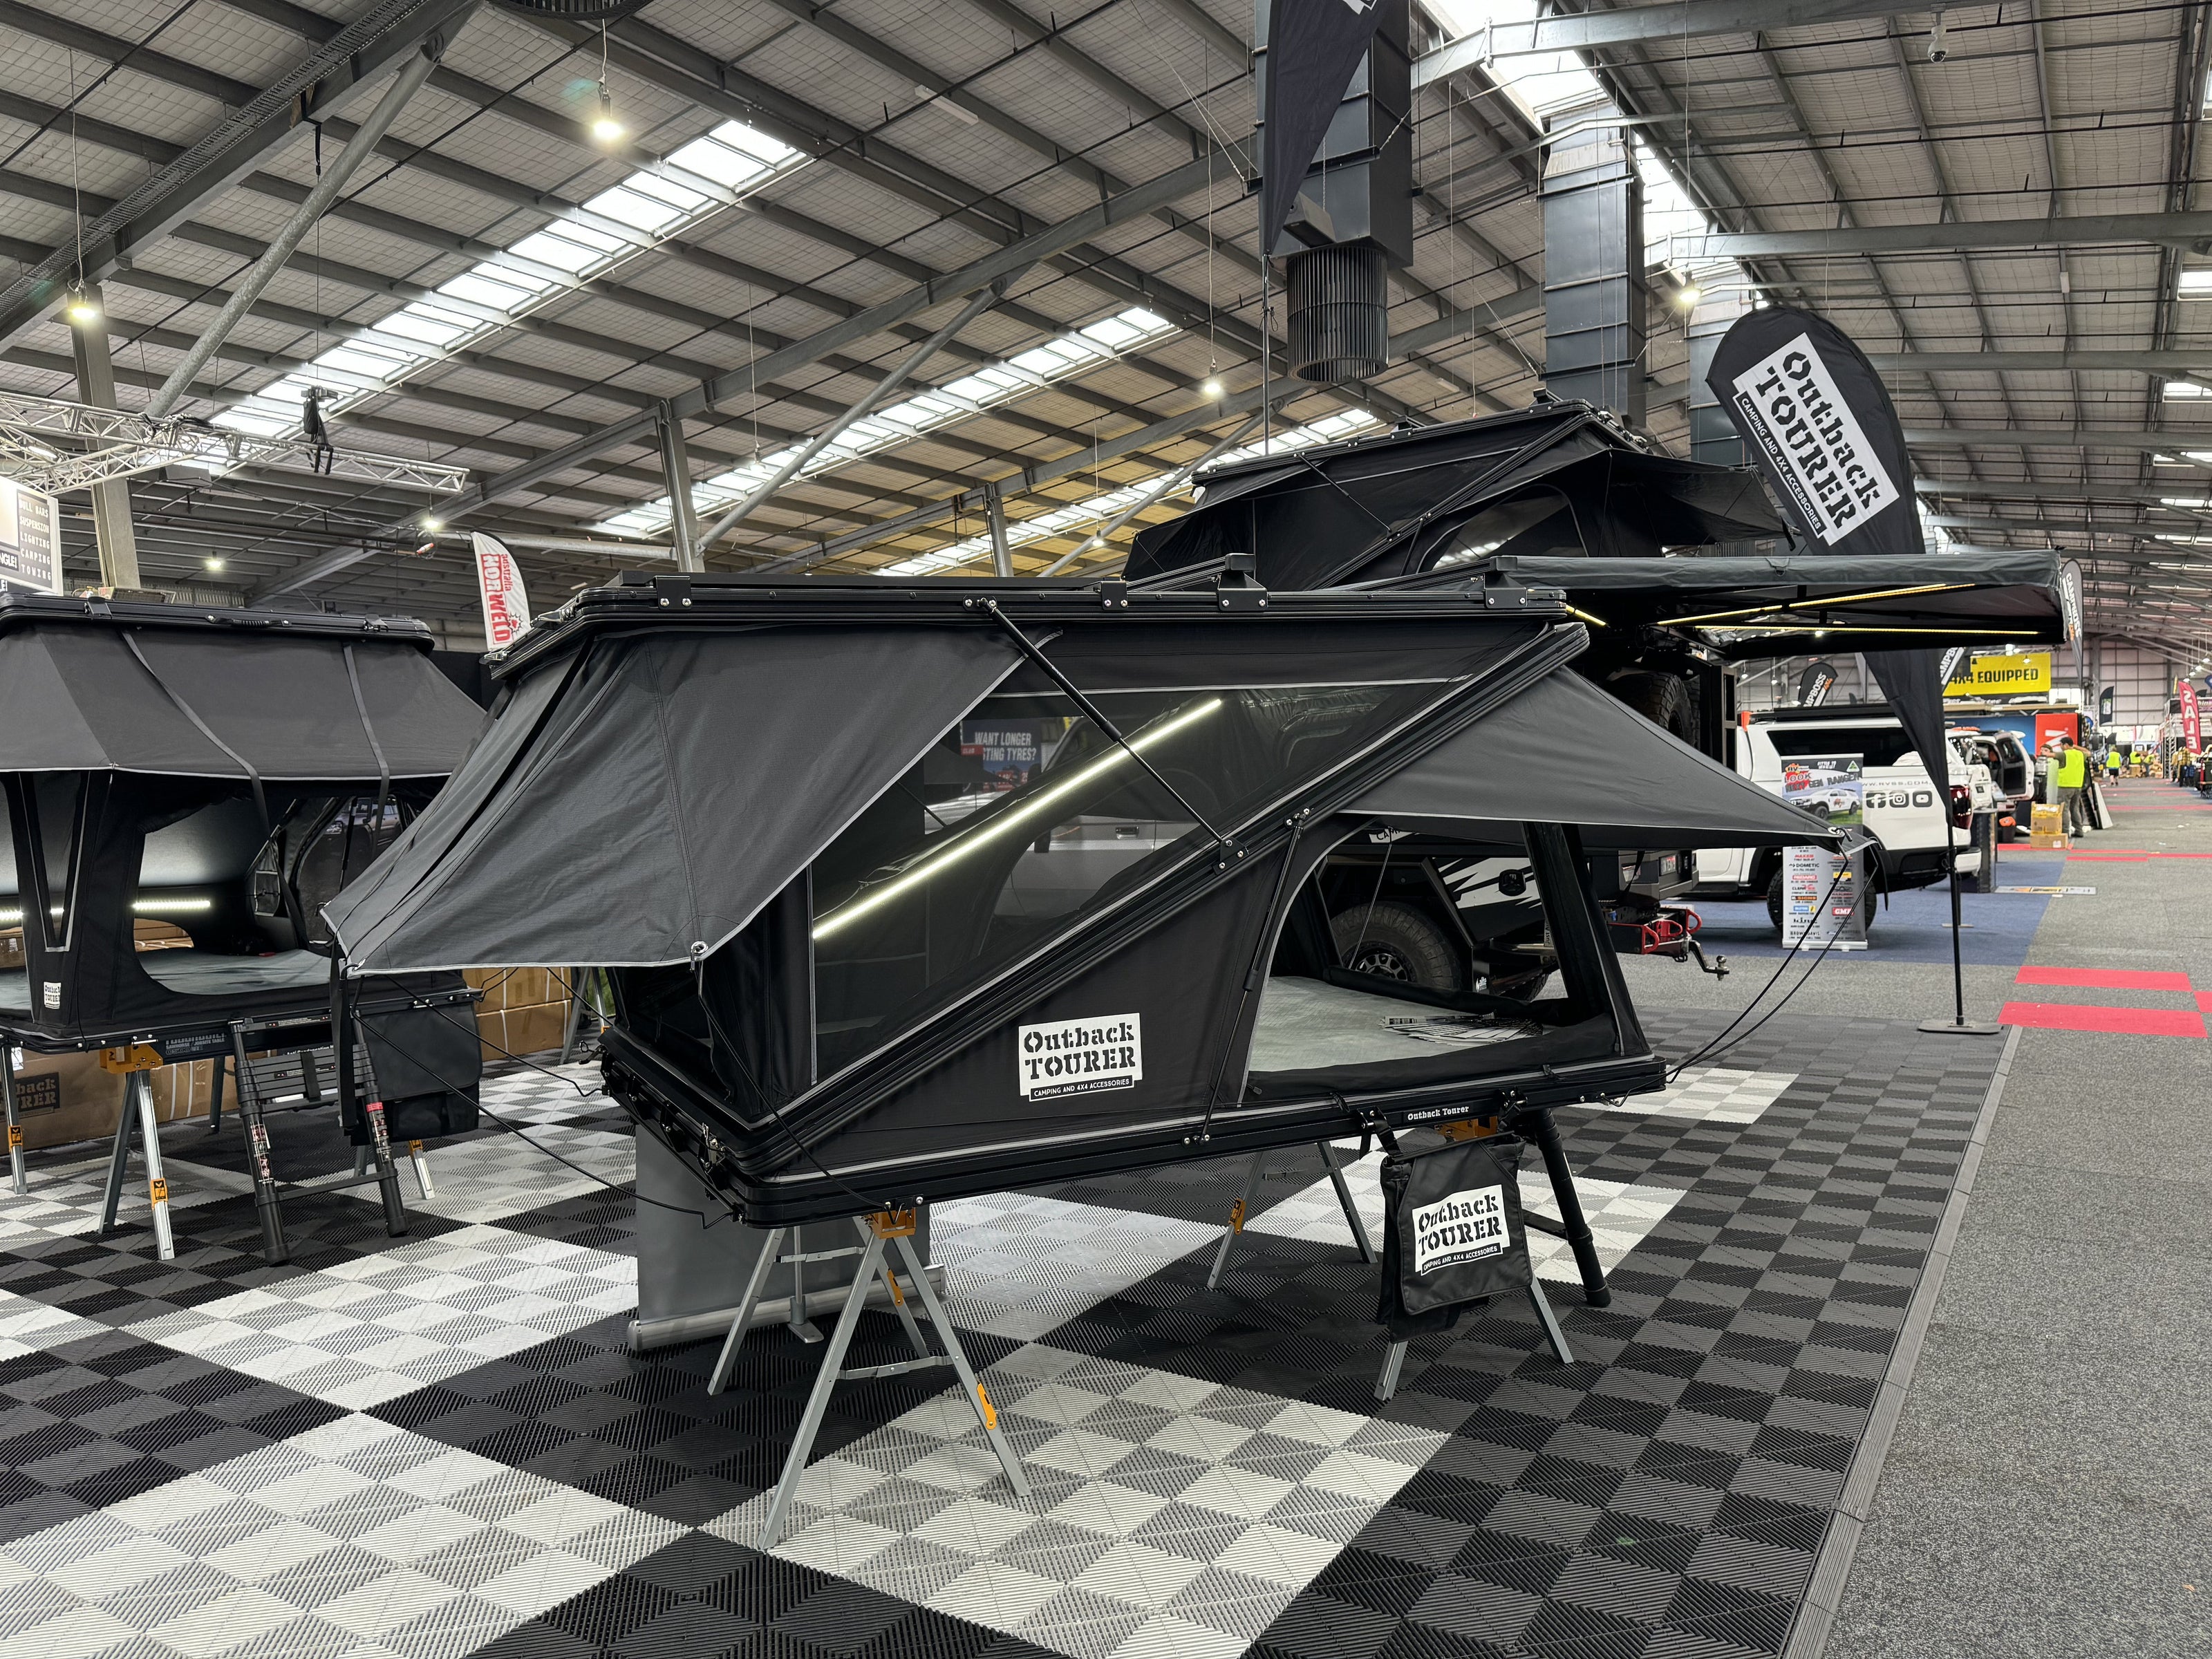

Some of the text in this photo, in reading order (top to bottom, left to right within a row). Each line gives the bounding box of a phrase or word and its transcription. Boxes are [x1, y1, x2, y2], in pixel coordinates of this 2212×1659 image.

[1783, 351, 1880, 510] Outback
[1755, 366, 1857, 529] TOURER
[1741, 397, 1821, 530] CAMPING AND 4X4 ACCESSORIES
[19, 499, 49, 518] BULL BARS
[19, 515, 50, 534] SUSPENSION
[20, 532, 50, 550] LIGHTING
[21, 547, 50, 565] CAMPING
[21, 563, 51, 581] TOWING
[501, 554, 513, 592] australia
[482, 555, 512, 641] NORWELD
[1978, 668, 2038, 683] EQUIPPED
[975, 731, 1031, 746] WANT LONGER
[1006, 747, 1037, 760] TYRES?
[1784, 773, 1812, 783] LOOK
[1024, 1022, 1134, 1053] Outback
[1024, 1047, 1136, 1080] TOURER
[1033, 1087, 1061, 1097] CAMPING
[1089, 1078, 1130, 1089] ACCESSORIES
[1407, 1106, 1469, 1121] Outback Tourer
[1418, 1194, 1499, 1232] Outback
[1418, 1216, 1502, 1257] TOURER
[1465, 1246, 1498, 1259] ACCESSORIES
